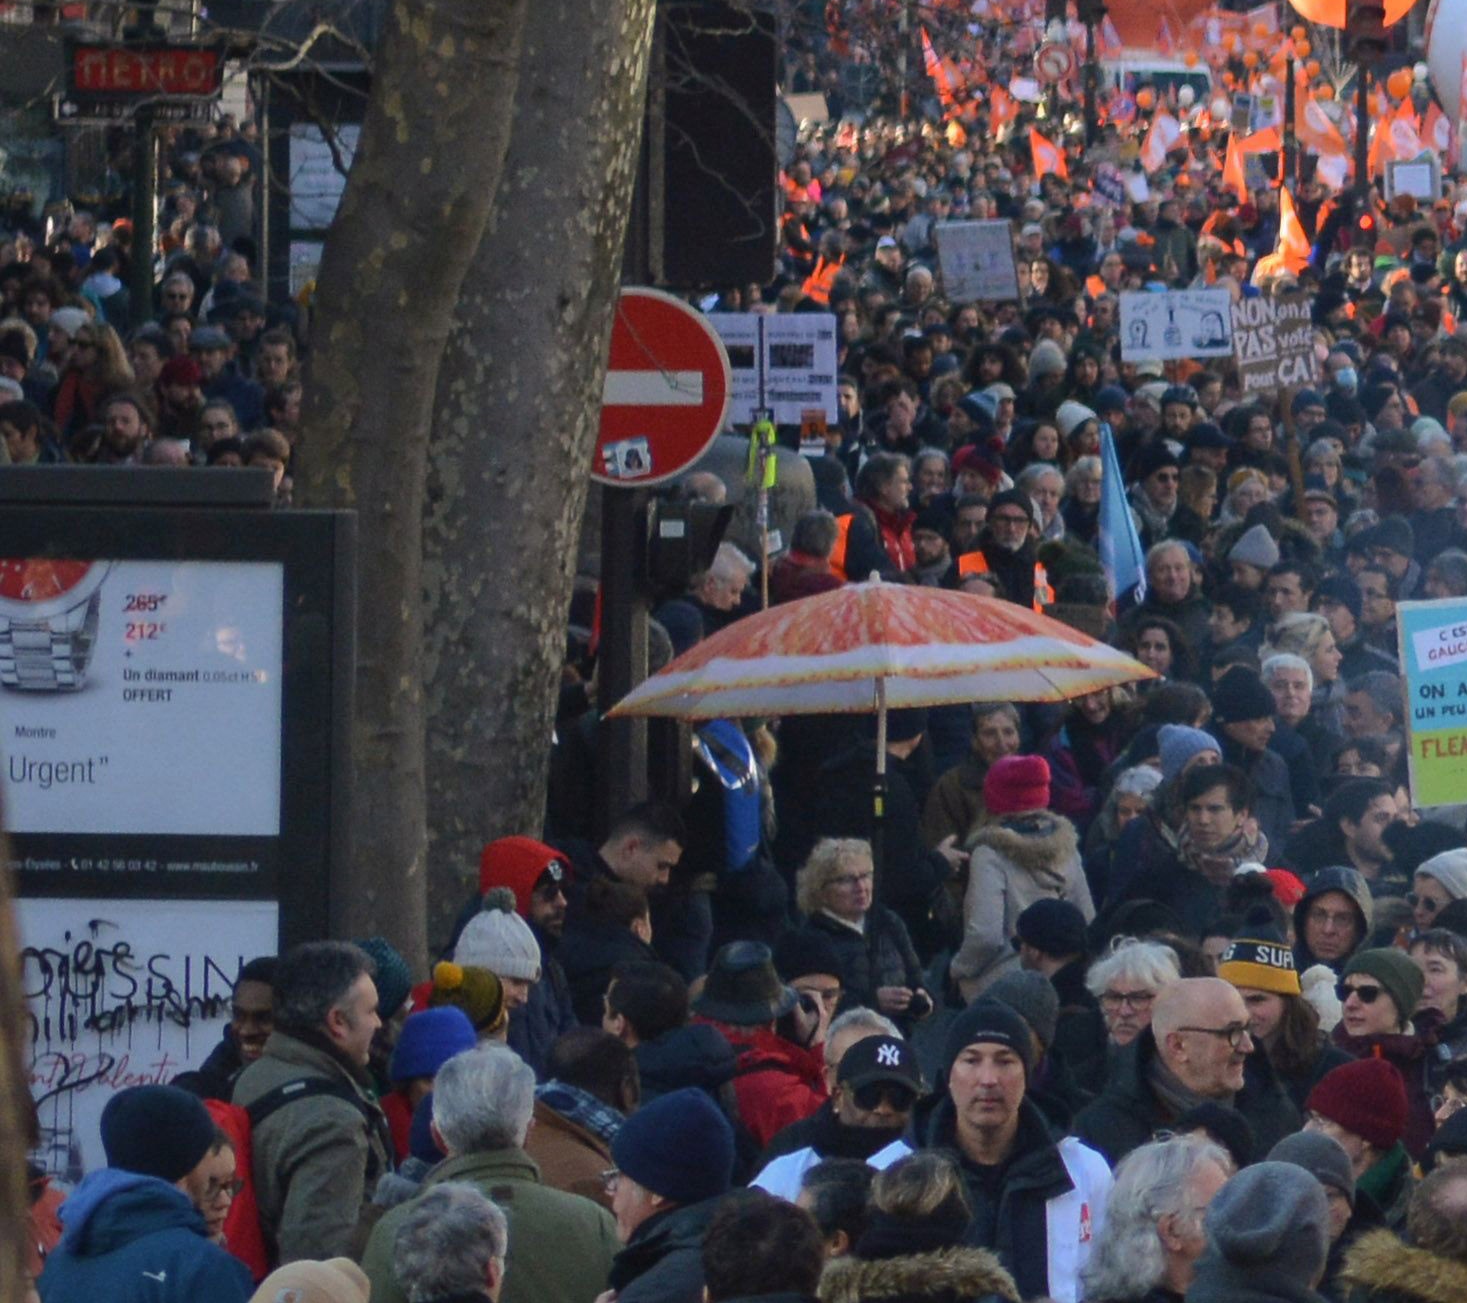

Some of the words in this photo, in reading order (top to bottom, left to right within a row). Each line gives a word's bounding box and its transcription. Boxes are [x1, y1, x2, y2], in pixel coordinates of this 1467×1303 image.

[1234, 324, 1277, 357] PAS
[123, 669, 142, 683] Un
[144, 668, 200, 683] diamant
[122, 688, 173, 703] OFFERT
[1419, 683, 1446, 700] ON
[1415, 705, 1436, 720] UN
[1441, 702, 1466, 716] PEU
[15, 725, 57, 740] Montre
